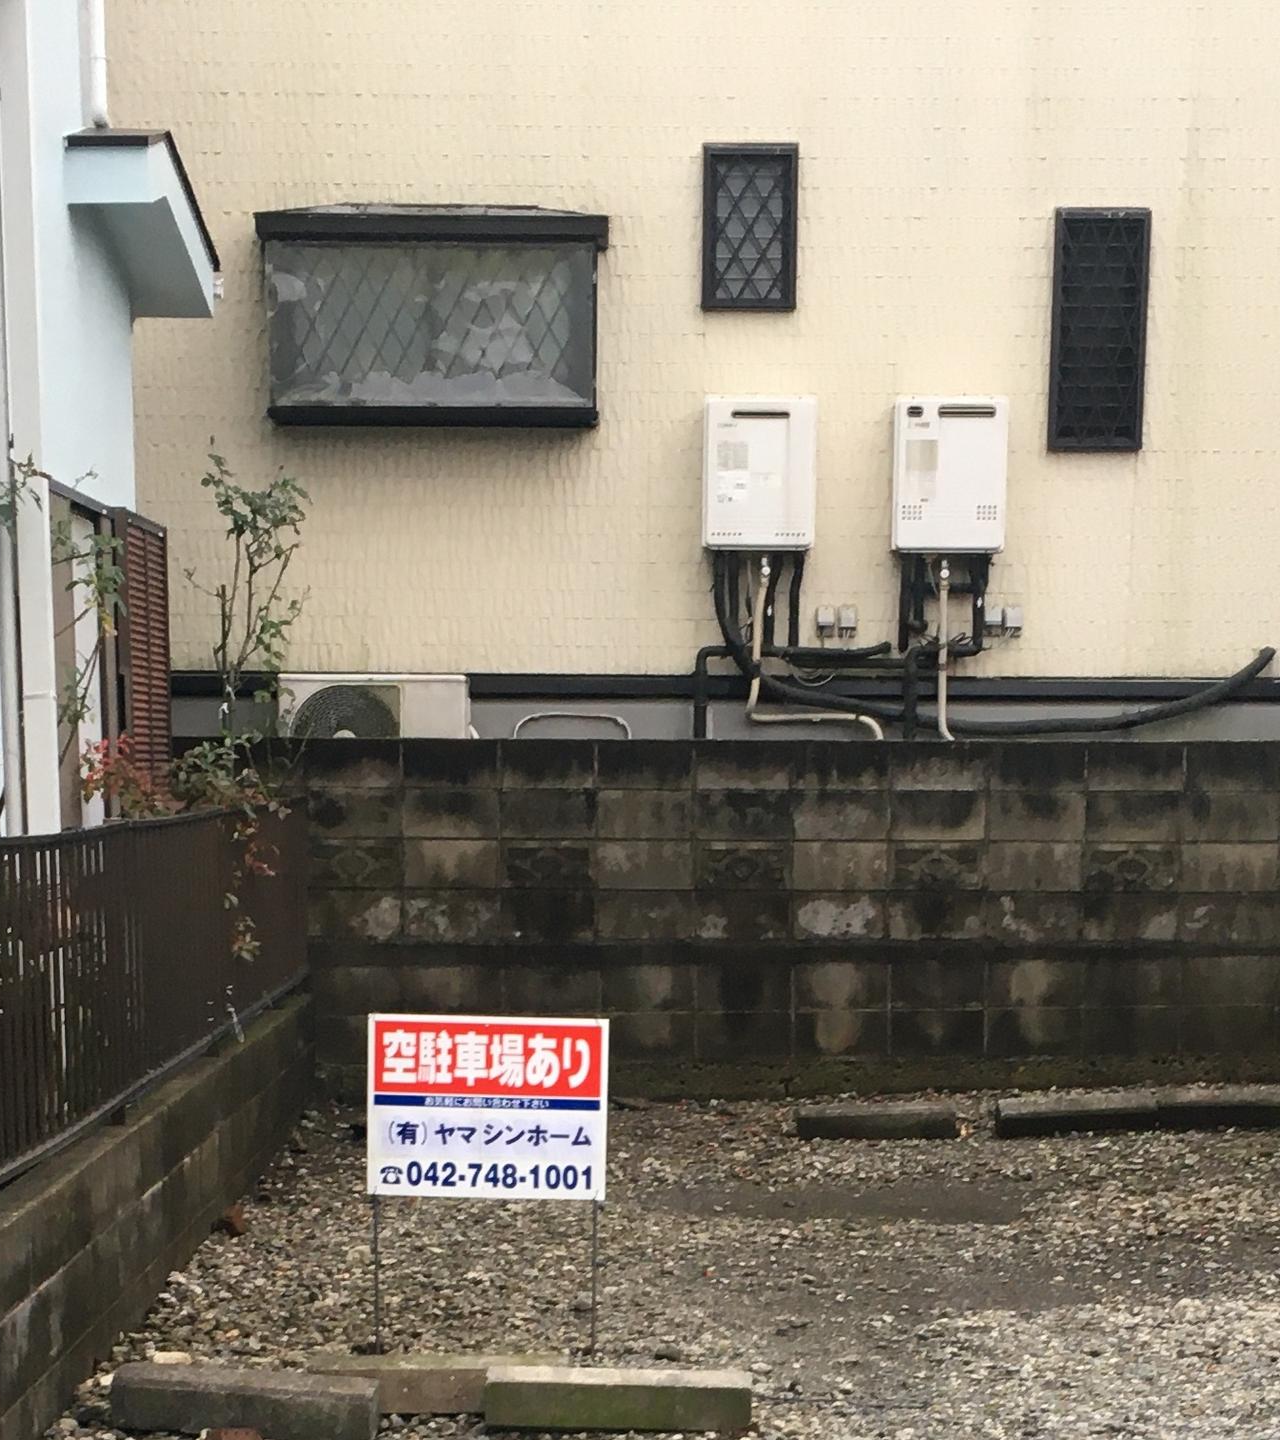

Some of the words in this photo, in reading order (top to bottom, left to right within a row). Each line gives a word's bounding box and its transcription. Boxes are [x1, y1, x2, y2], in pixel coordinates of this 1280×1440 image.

[382, 1030, 591, 1089] 空駐車場あり
[406, 1160, 593, 1191] 042-748-1001
